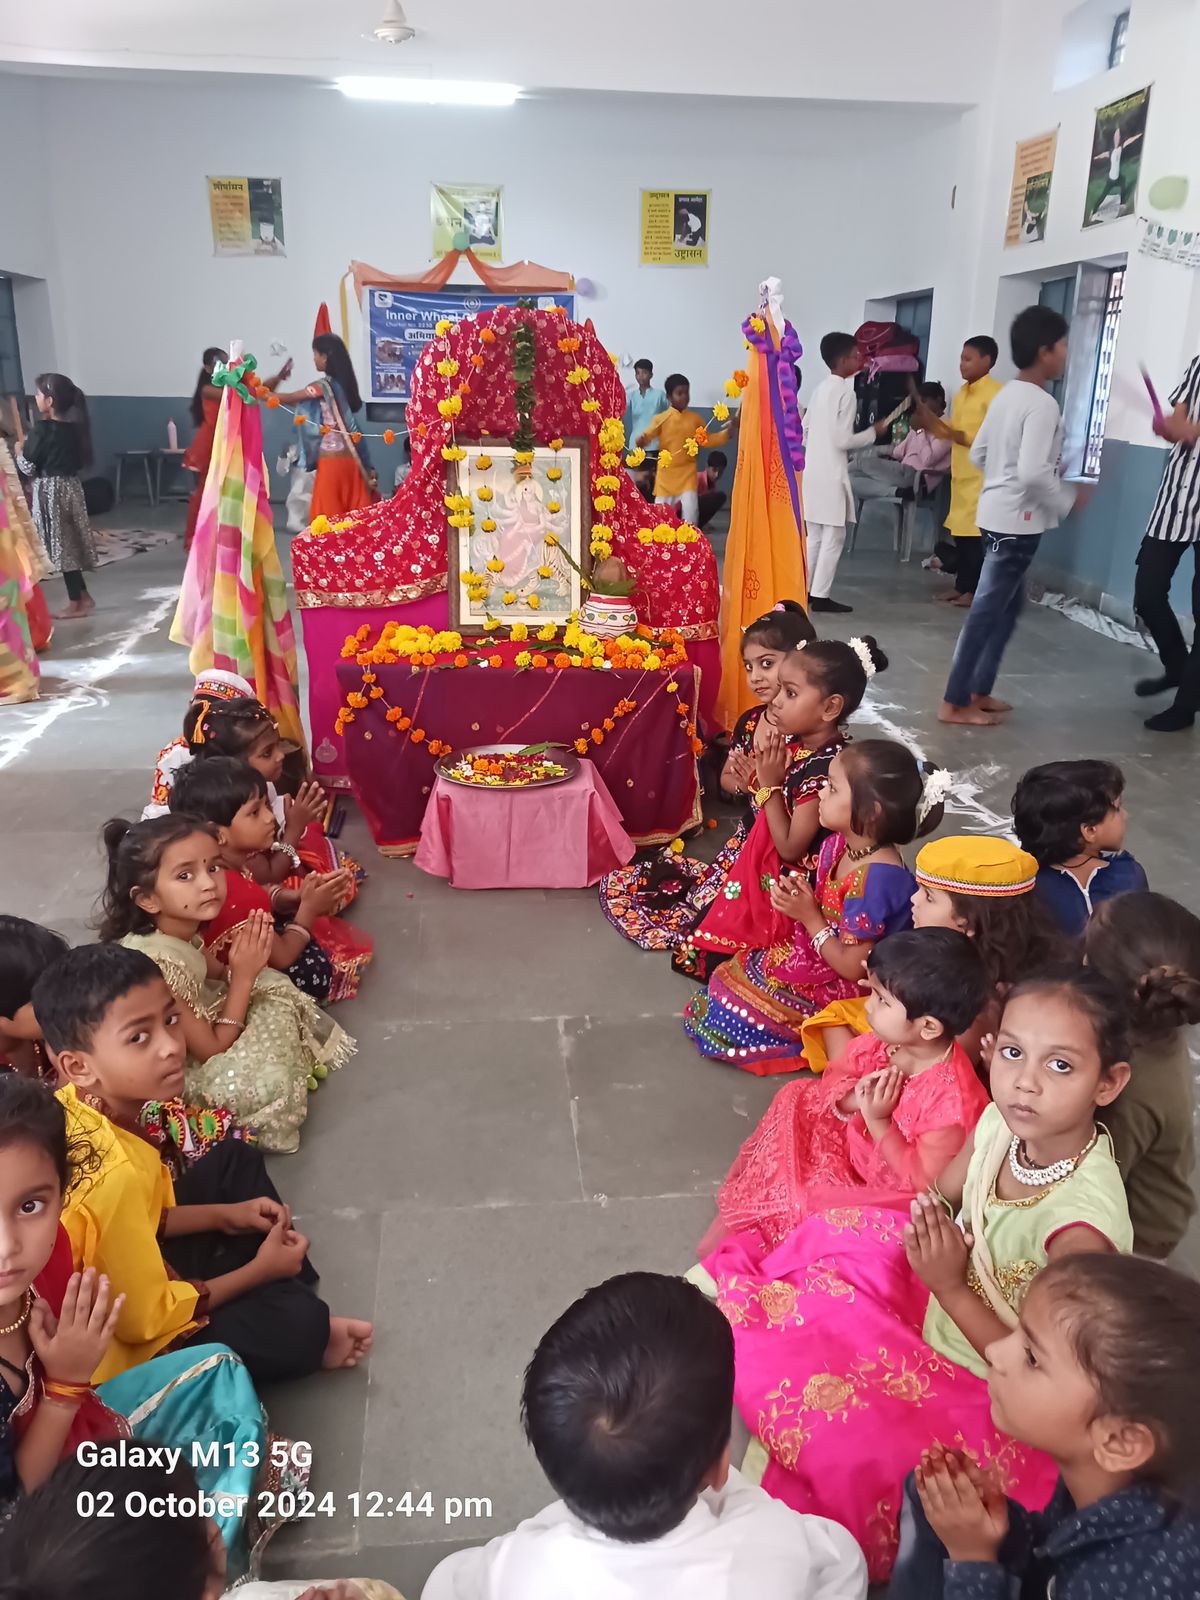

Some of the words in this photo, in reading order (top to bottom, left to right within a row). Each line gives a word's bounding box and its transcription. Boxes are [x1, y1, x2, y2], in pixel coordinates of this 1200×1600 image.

[674, 249, 703, 260] उष्ट्रासन
[385, 309, 418, 321] Inner
[407, 331, 437, 340] अभिया
